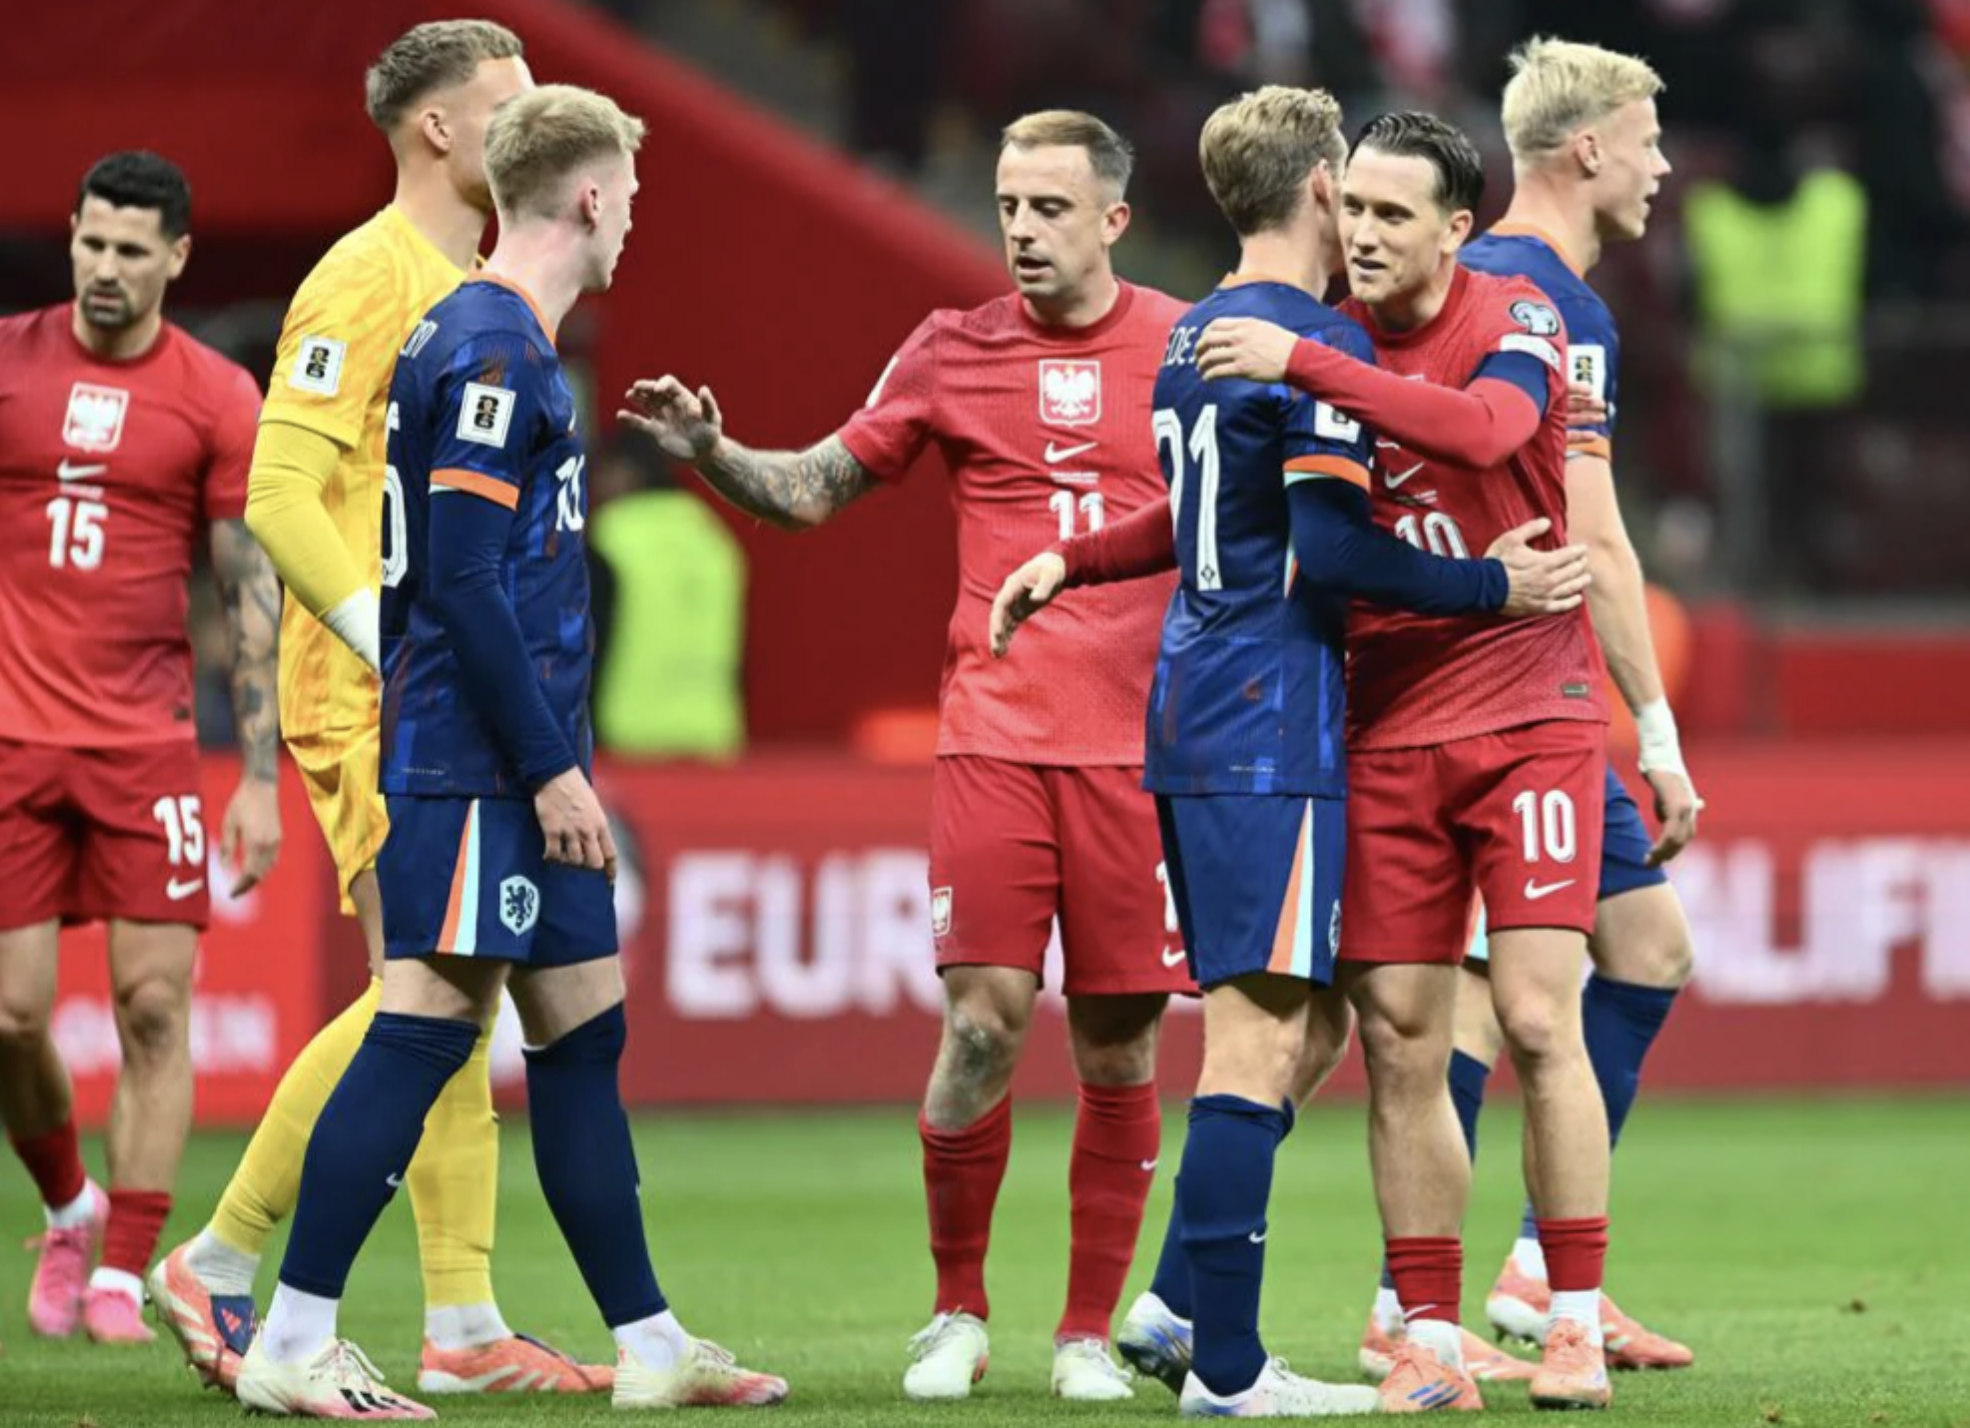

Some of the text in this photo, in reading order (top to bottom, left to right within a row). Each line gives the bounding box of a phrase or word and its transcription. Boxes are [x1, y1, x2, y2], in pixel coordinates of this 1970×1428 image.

[46, 497, 109, 570] 15
[1049, 489, 1105, 541] 11
[1394, 511, 1470, 560] 10
[153, 794, 205, 867] 15
[1512, 789, 1577, 864] 10
